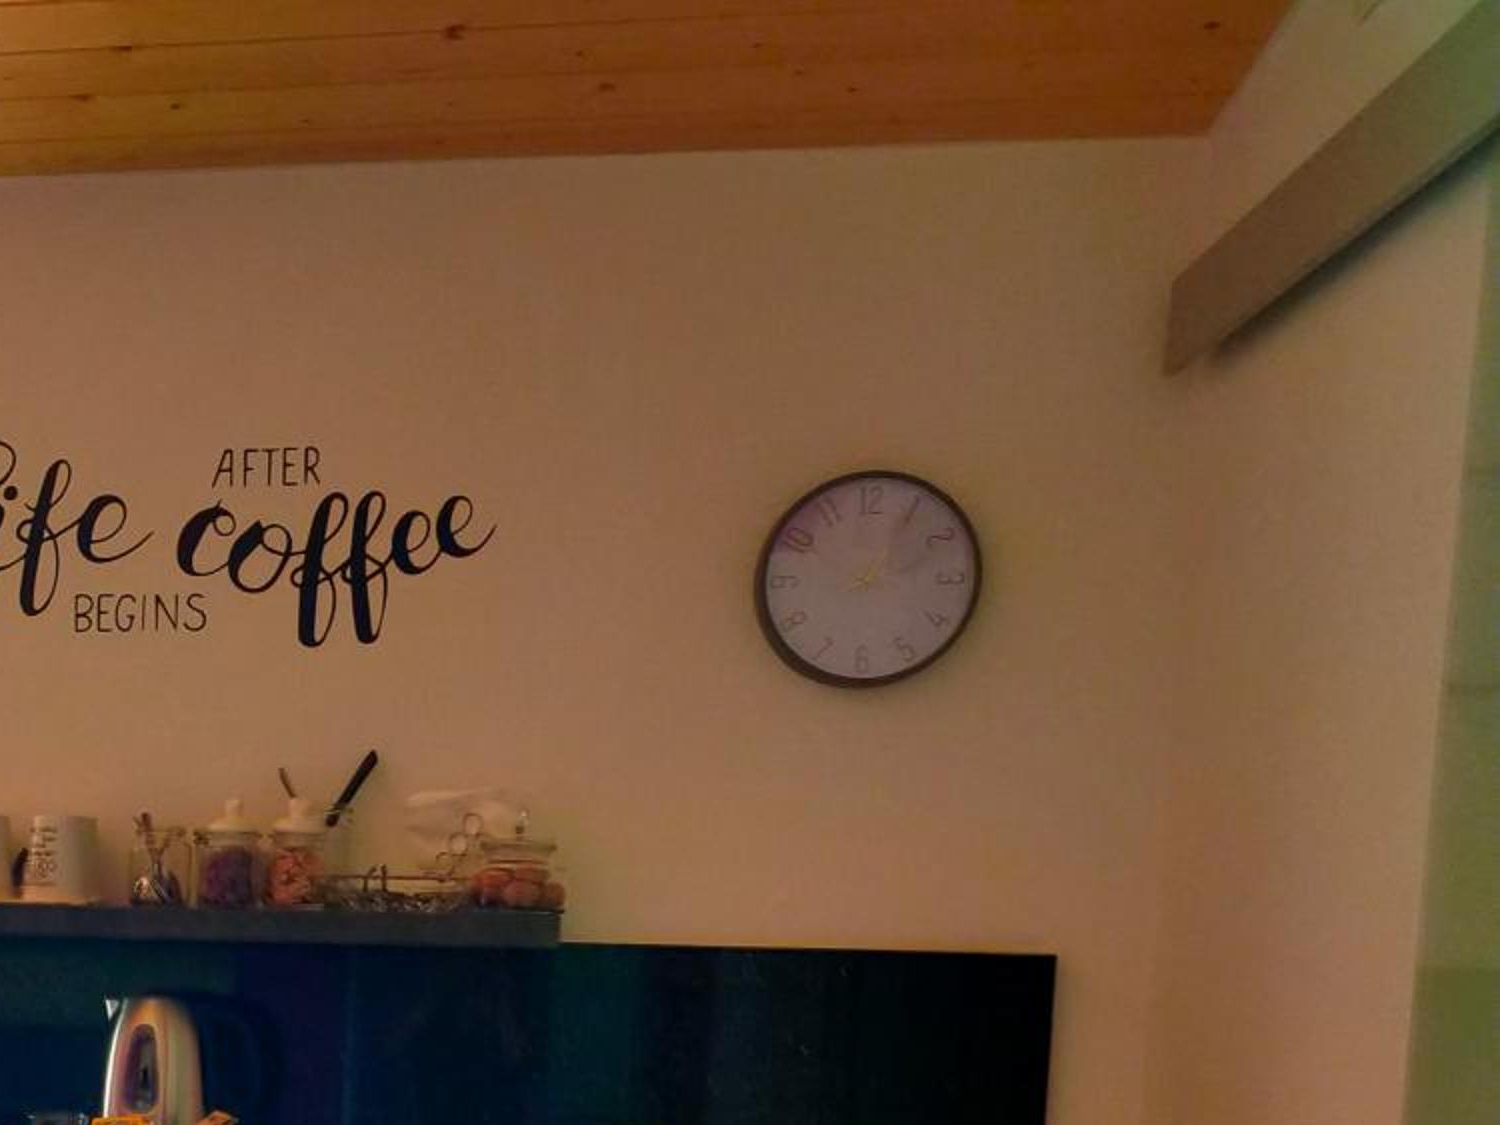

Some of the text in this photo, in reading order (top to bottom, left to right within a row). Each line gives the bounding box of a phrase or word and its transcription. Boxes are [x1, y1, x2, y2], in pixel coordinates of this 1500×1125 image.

[211, 445, 322, 489] AFTER
[858, 486, 885, 516] 12
[904, 496, 921, 527] 1
[780, 527, 816, 553] 10
[926, 527, 956, 548] 2
[176, 490, 498, 649] coffee
[935, 571, 965, 586] 3
[73, 592, 208, 634] BEGINS
[924, 609, 949, 628] 4
[853, 645, 870, 675] 6
